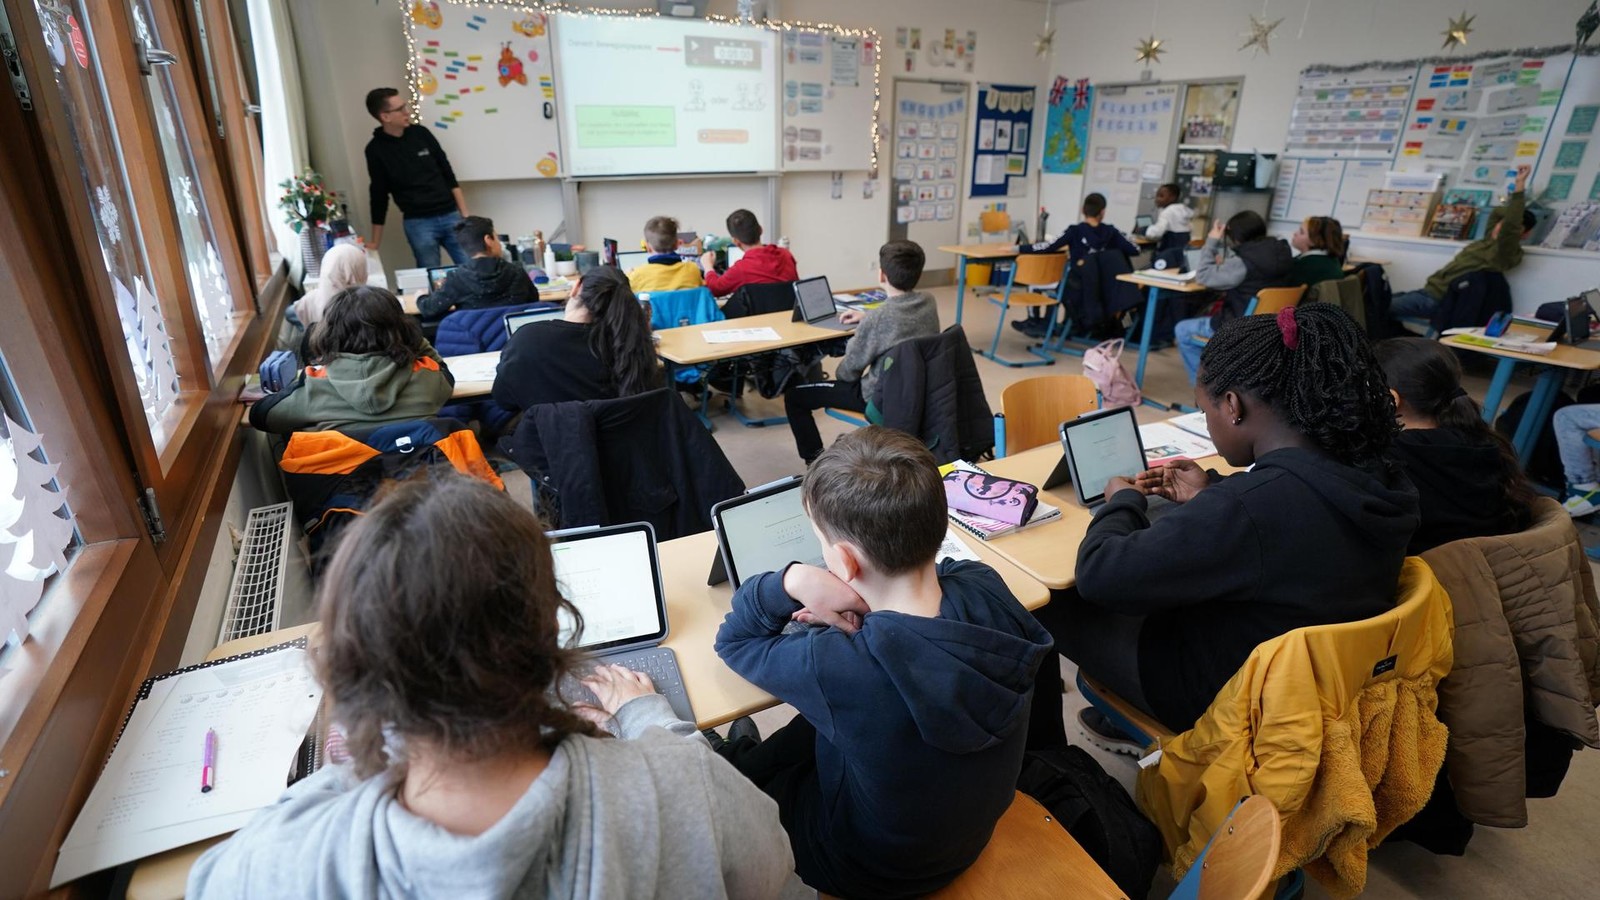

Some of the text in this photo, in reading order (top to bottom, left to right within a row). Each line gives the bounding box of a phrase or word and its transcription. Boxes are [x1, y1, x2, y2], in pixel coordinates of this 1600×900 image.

[989, 91, 1032, 108] INFO
[1101, 99, 1170, 114] KLASSEN
[900, 99, 964, 118] ENGLISH
[1097, 119, 1158, 131] REGELN
